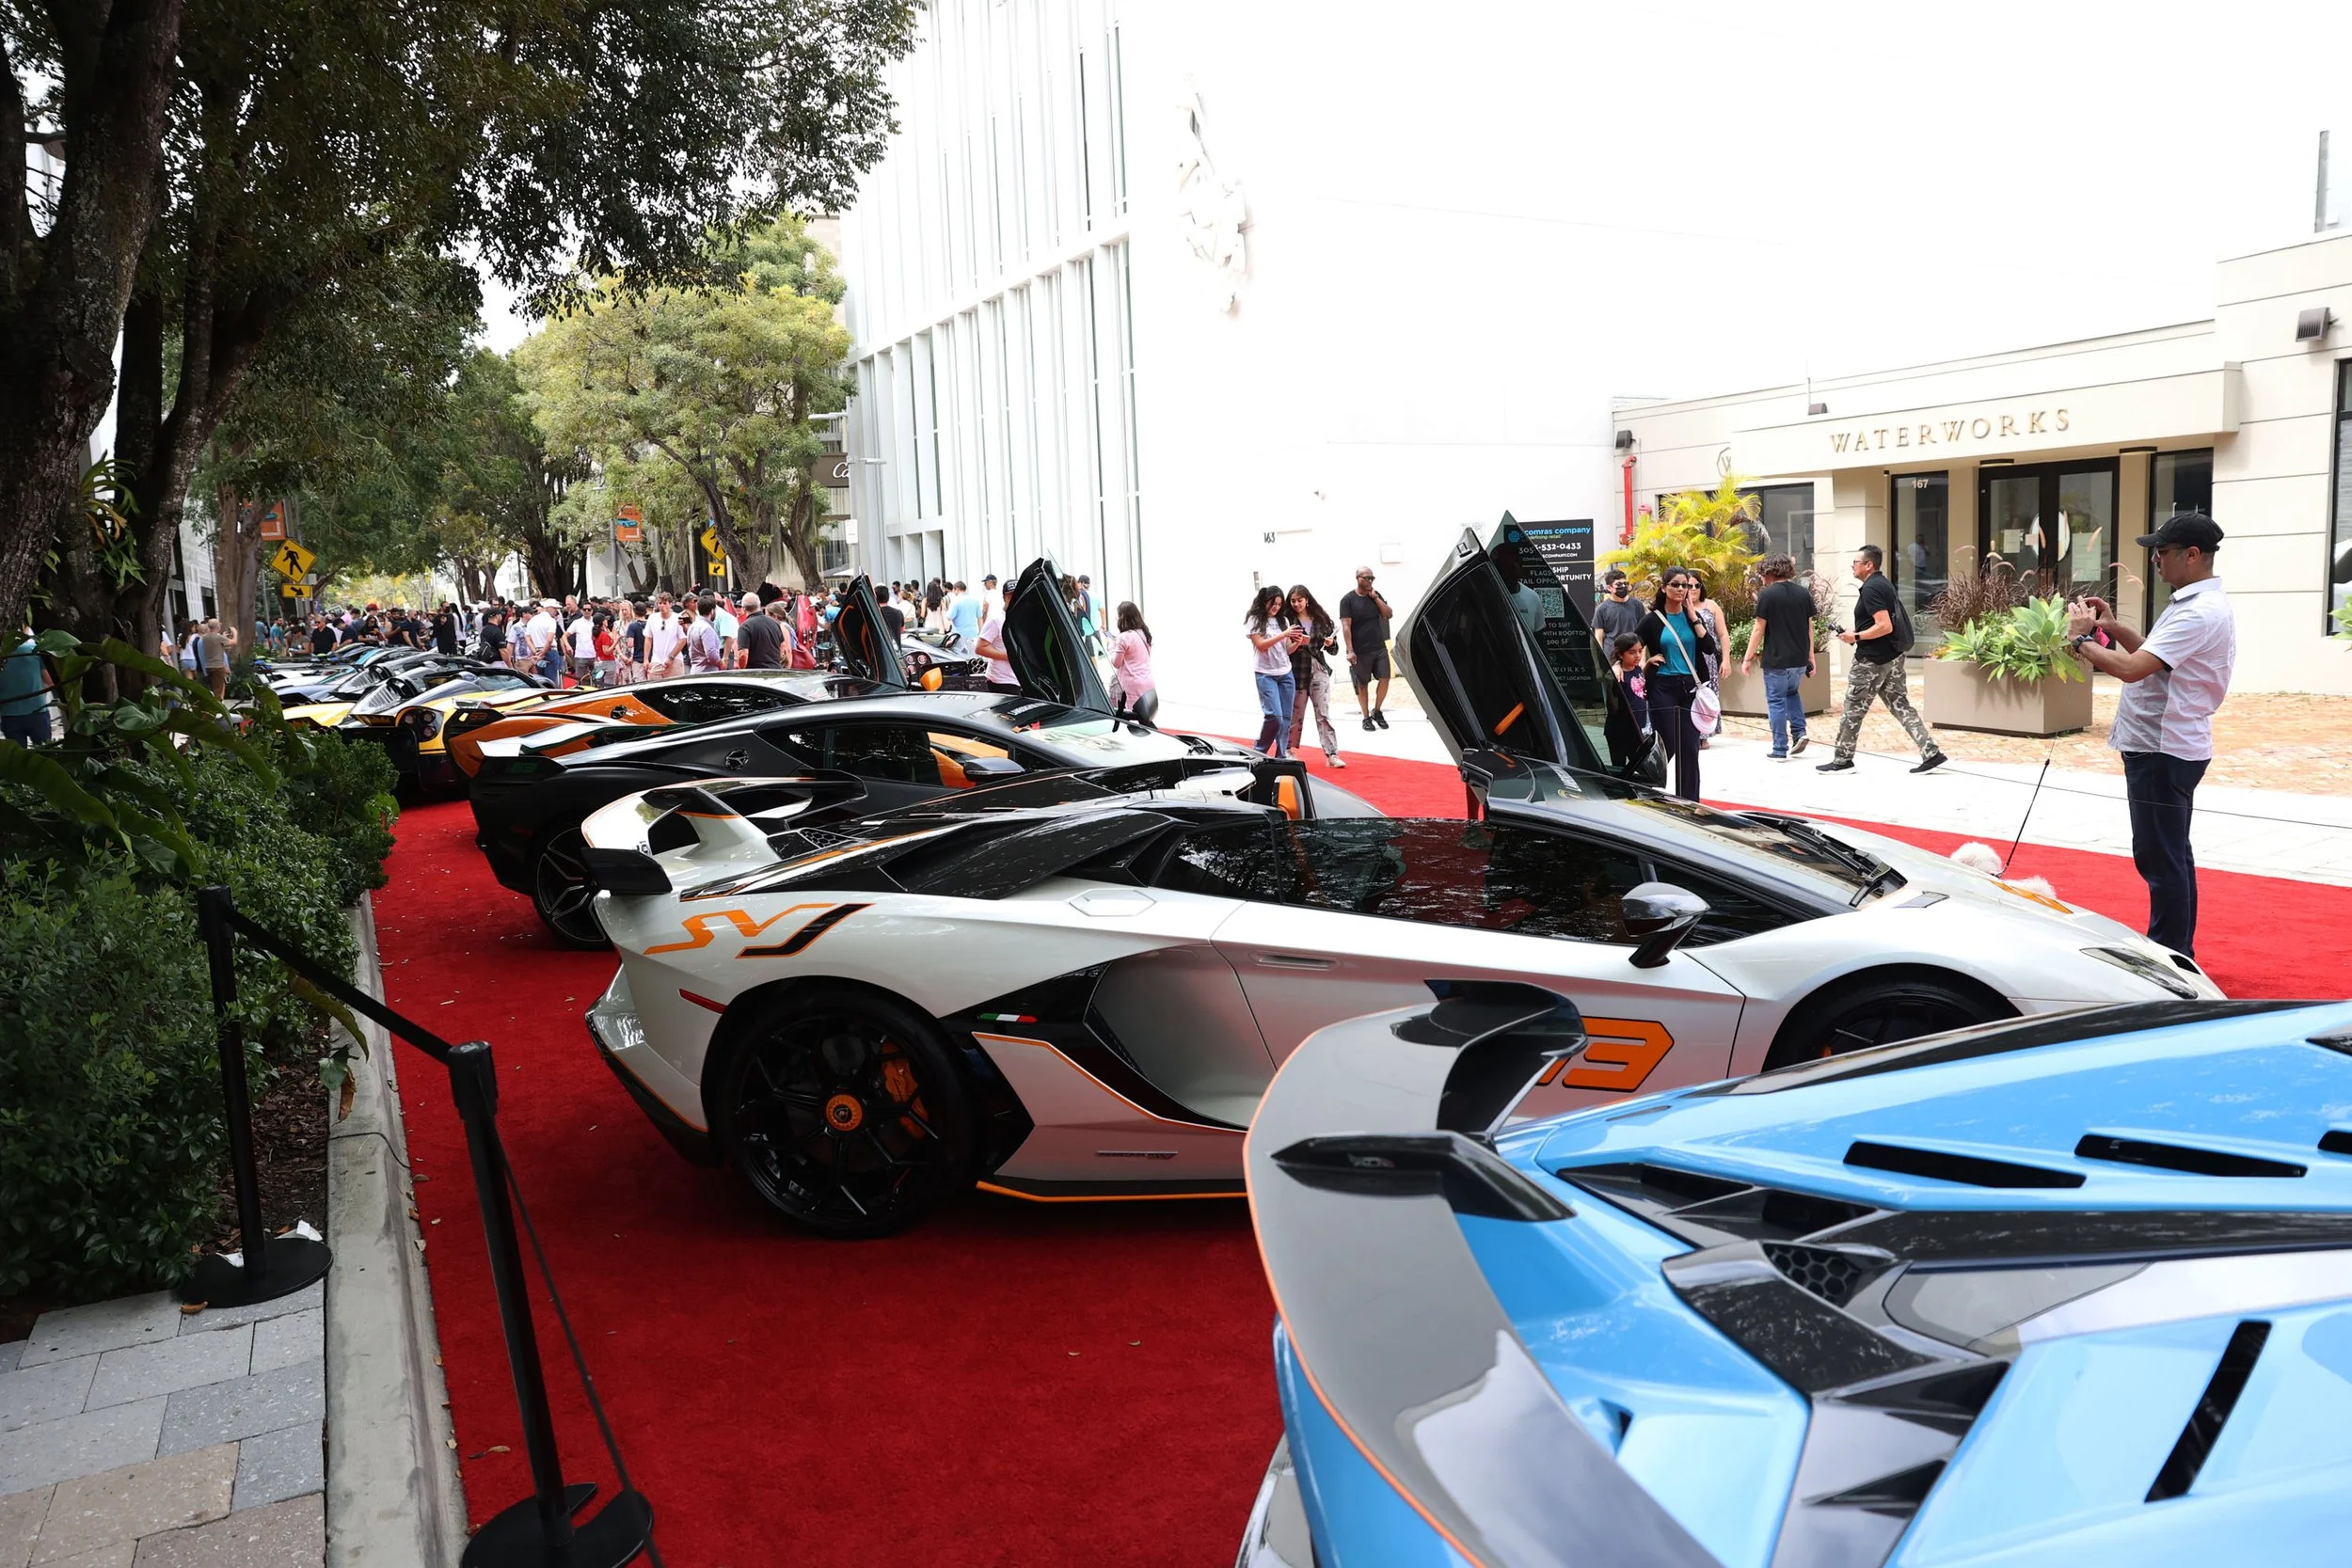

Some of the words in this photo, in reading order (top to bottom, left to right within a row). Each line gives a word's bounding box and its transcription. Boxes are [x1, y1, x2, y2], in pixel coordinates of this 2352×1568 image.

[1830, 408, 2070, 453] WATERWORKS
[1912, 479, 1929, 489] 167
[1554, 527, 1591, 535] company
[1535, 1016, 1675, 1092] 3
